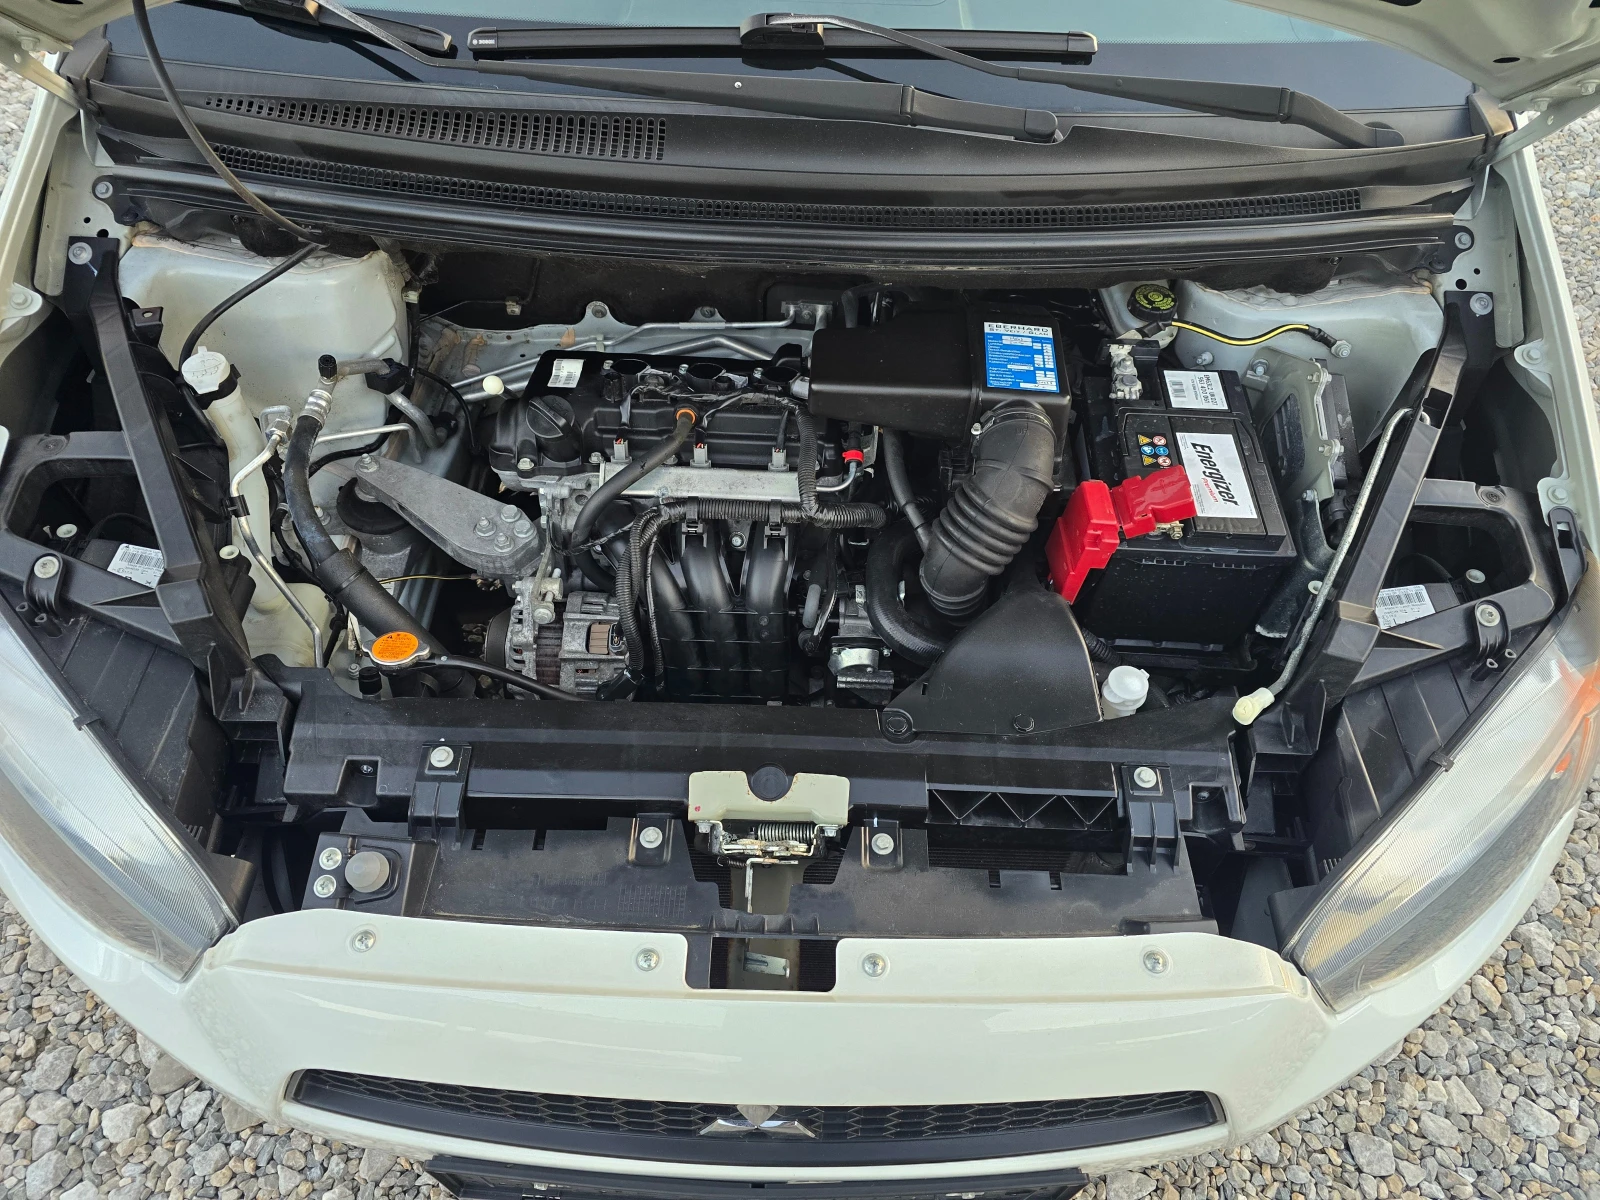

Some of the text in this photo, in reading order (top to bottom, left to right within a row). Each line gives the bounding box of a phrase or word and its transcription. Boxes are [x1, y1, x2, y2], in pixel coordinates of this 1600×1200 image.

[988, 324, 1049, 332] EBERHARD
[1190, 442, 1240, 506] Energizer
[1201, 477, 1219, 503] Premium
